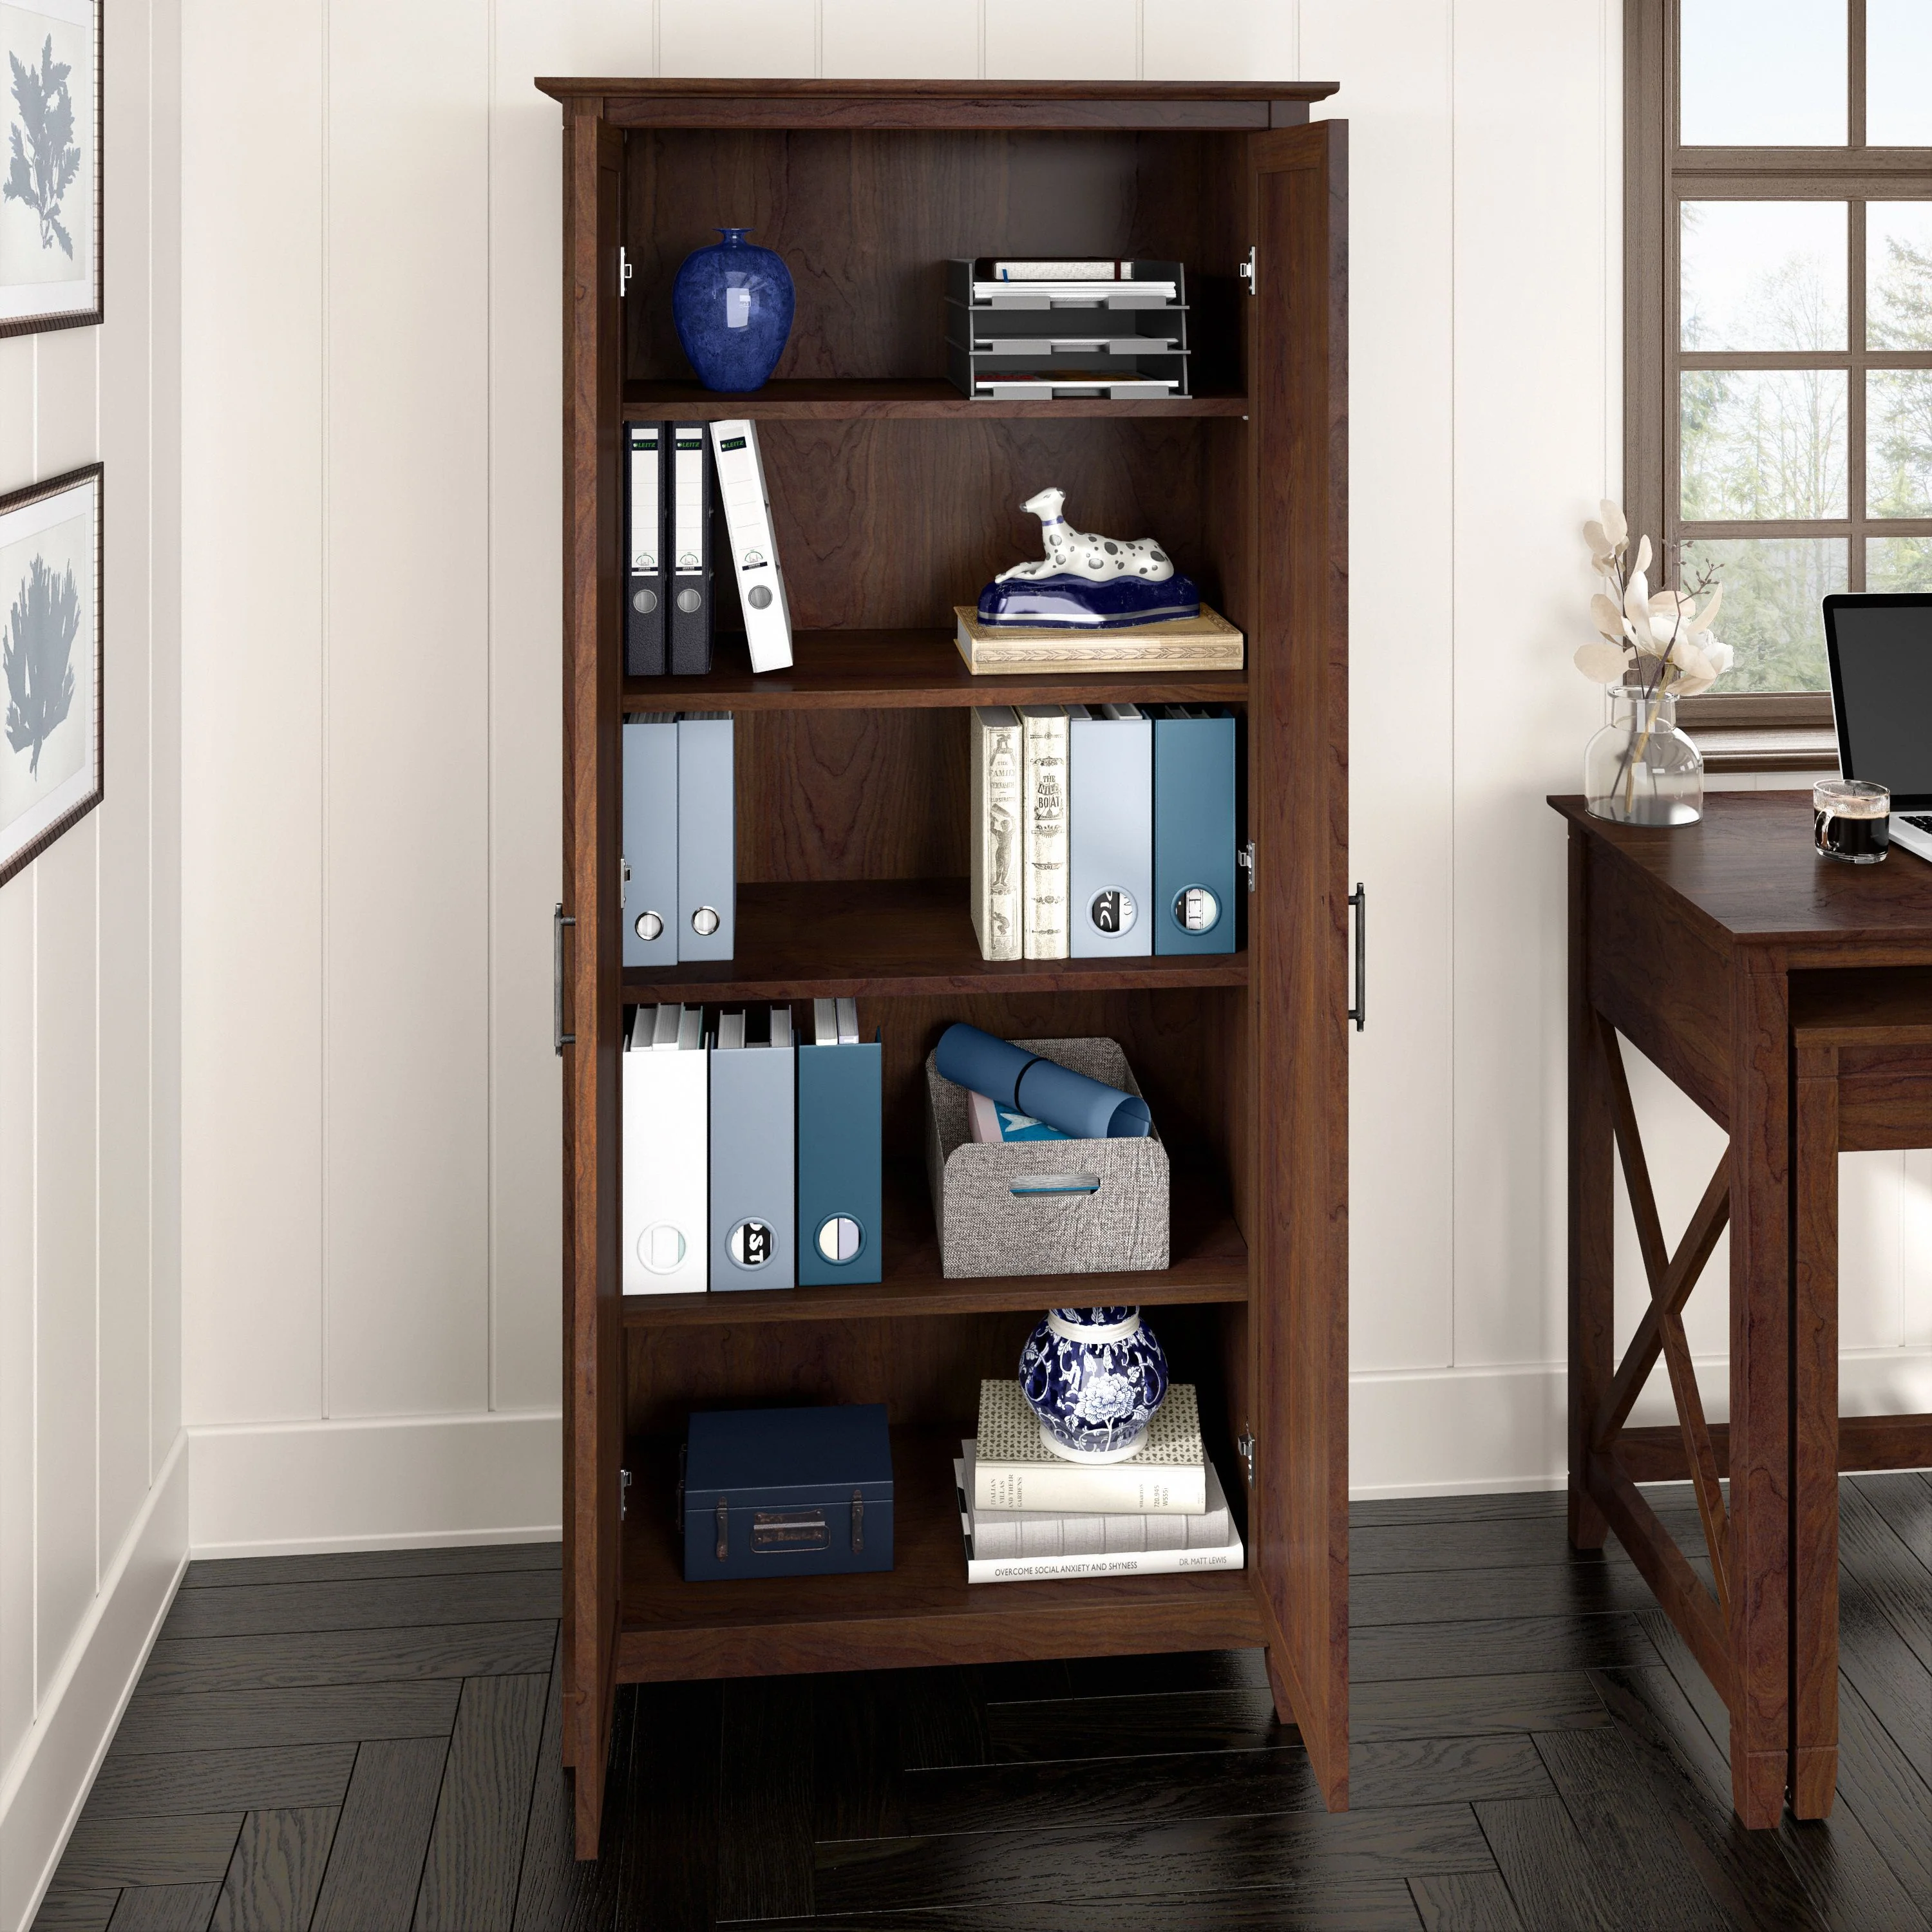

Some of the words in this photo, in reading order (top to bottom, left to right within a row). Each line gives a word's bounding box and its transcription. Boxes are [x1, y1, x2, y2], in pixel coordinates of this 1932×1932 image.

[726, 440, 744, 448] LEITZ
[1043, 775, 1056, 783] THE
[1038, 796, 1059, 808] BOAT
[1209, 1556, 1227, 1564] LEWIS
[995, 1567, 1033, 1576] OVERCOME
[1035, 1566, 1059, 1574] SOCIAL
[1060, 1564, 1090, 1573] ANXIETY
[1092, 1562, 1107, 1571] AND
[1108, 1561, 1137, 1570] SHYNESS
